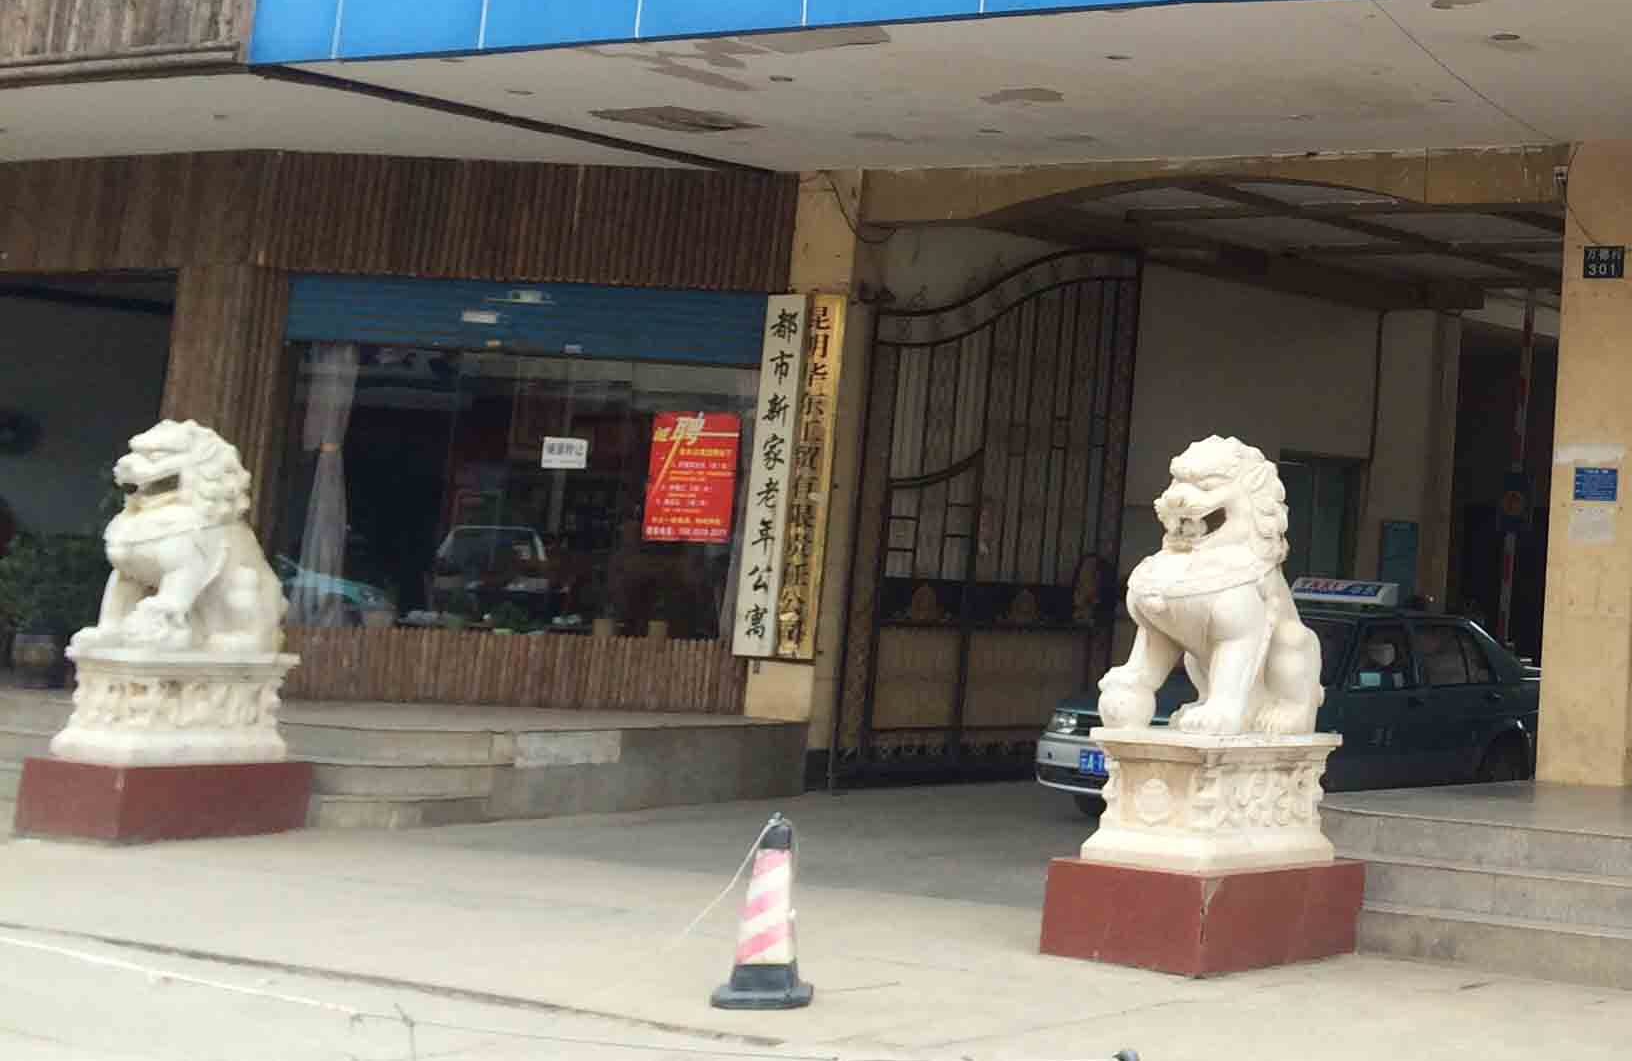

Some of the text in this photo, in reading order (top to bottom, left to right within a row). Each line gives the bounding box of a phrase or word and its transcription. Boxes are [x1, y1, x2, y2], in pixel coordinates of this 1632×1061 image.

[1588, 263, 1616, 276] 301
[744, 307, 799, 640] 都市新家老年公寓
